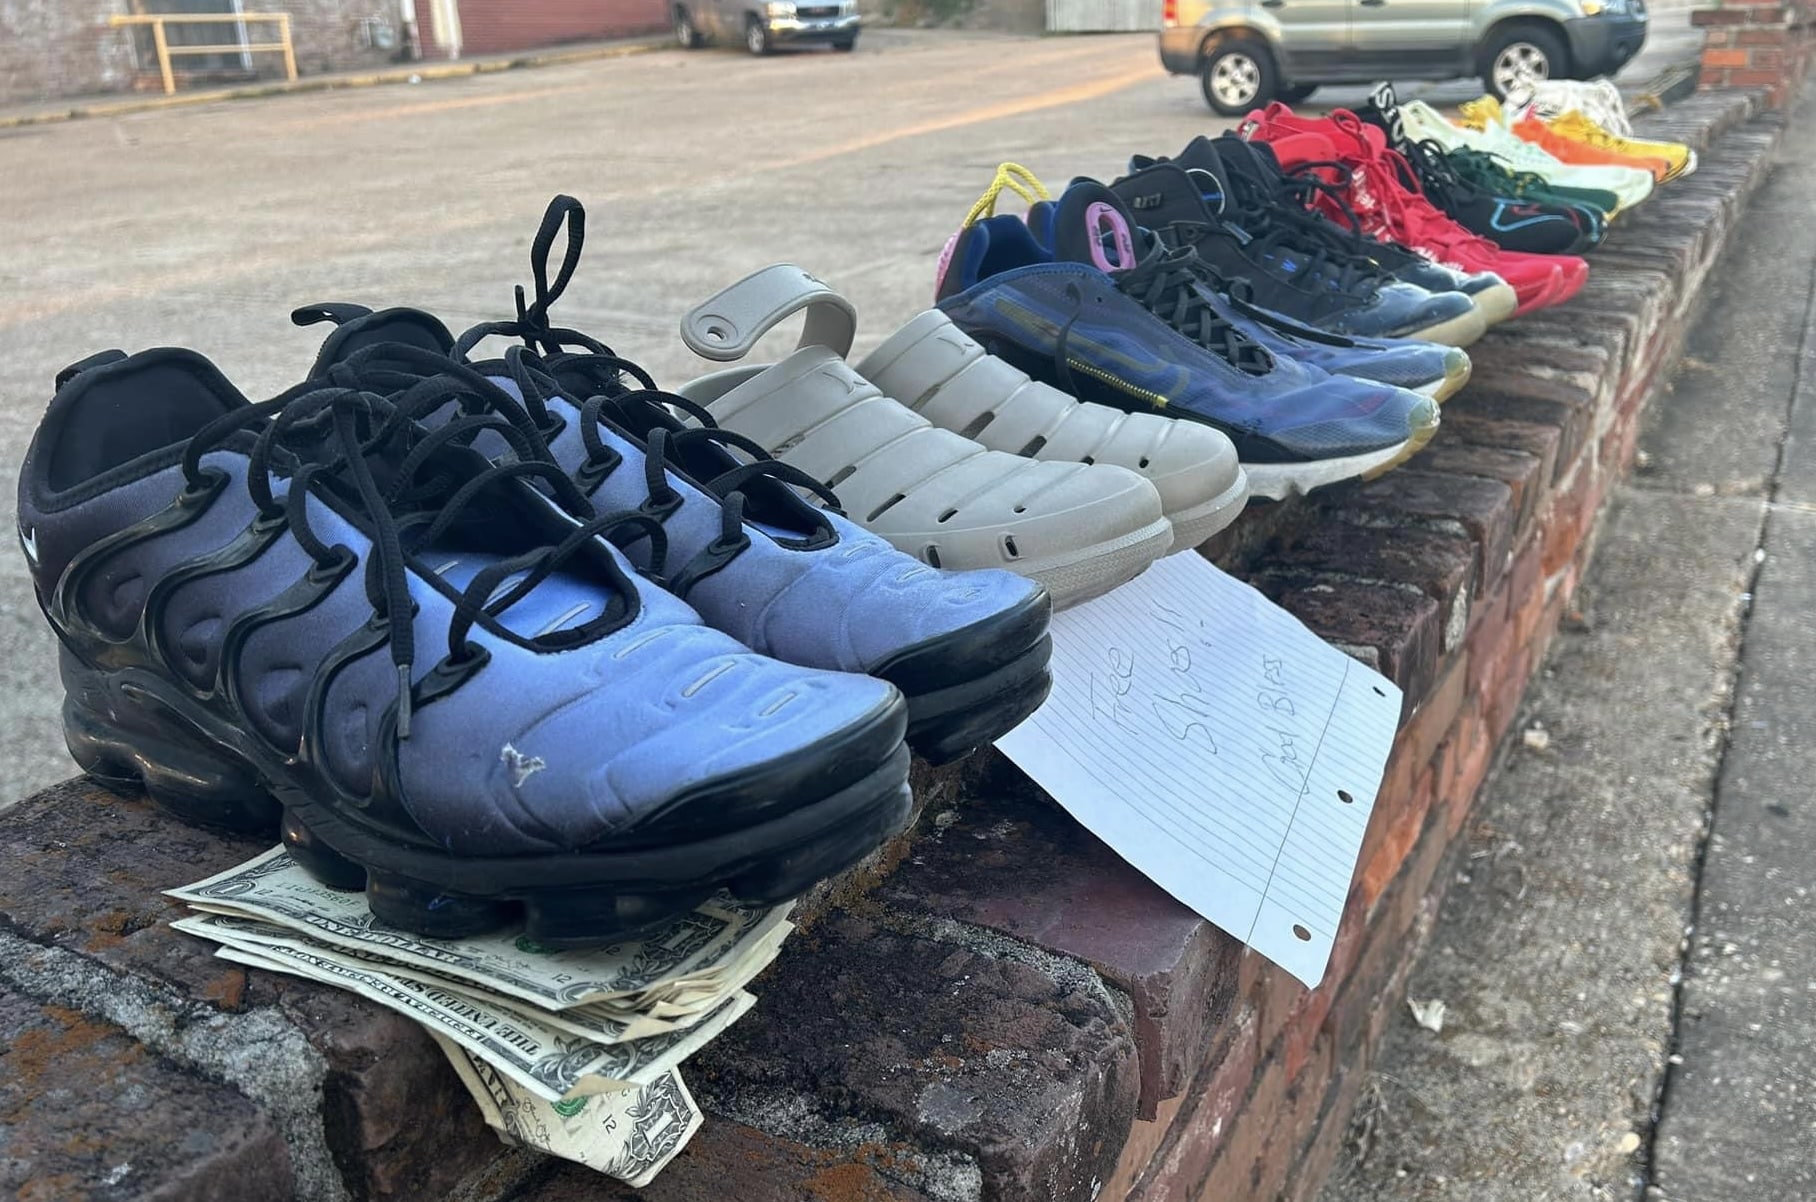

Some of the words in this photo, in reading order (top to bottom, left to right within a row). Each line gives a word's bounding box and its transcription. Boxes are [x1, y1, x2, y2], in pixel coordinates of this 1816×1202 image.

[1090, 646, 1139, 736] Free
[1256, 653, 1296, 717] Bless
[1258, 725, 1311, 796] God
[305, 914, 358, 937] ONE
[357, 930, 461, 964] DOLLAR
[318, 959, 403, 1001] RESERVE
[400, 992, 484, 1042] FEDERAL
[427, 987, 499, 1031] UNITED
[496, 1023, 541, 1056] THE
[601, 1113, 617, 1135] 12
